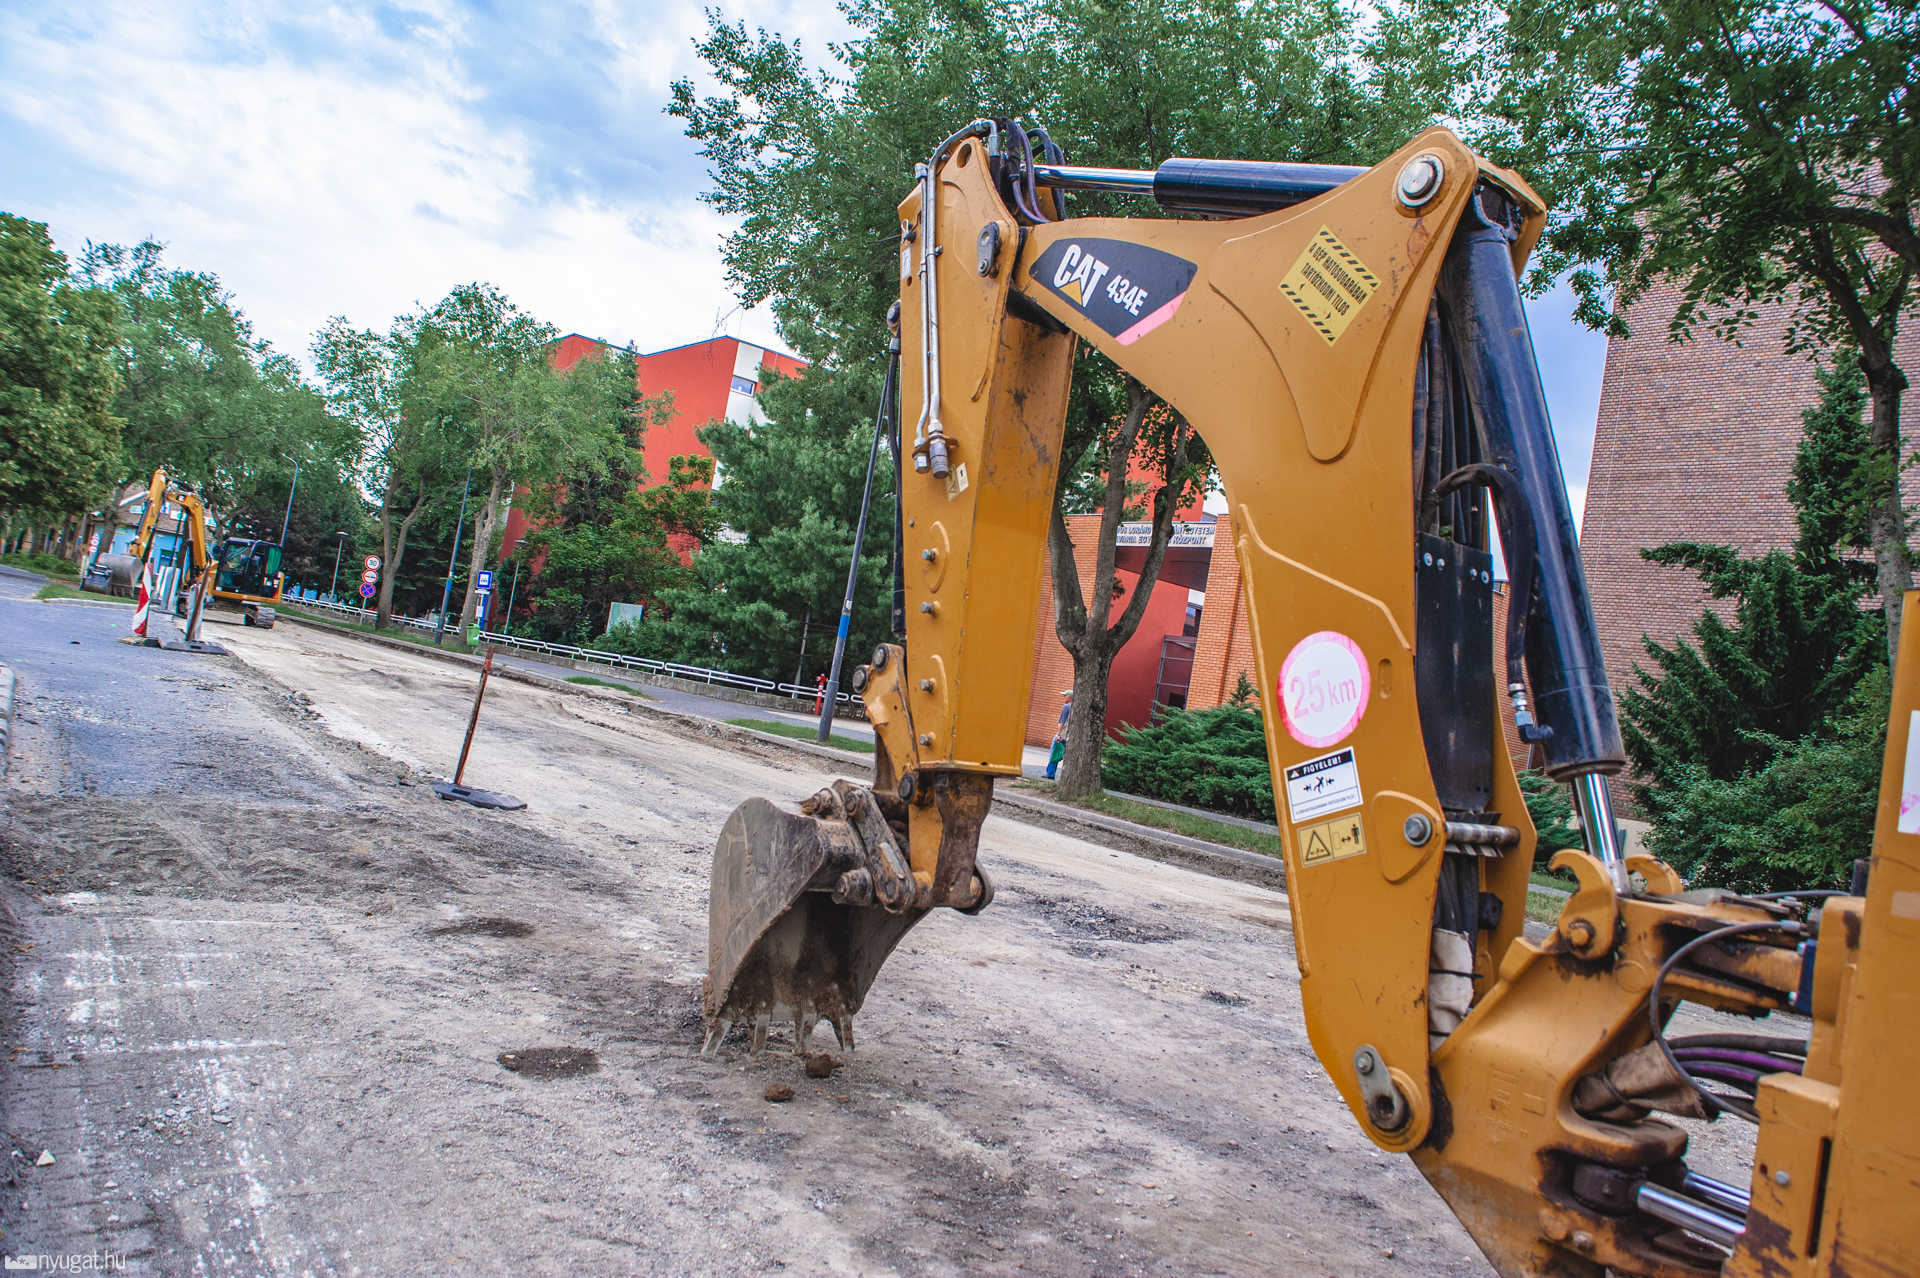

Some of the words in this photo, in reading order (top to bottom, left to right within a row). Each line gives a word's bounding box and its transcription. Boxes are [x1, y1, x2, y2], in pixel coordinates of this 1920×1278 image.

[1053, 244, 1109, 308] CAT
[1106, 275, 1149, 317] 434E
[1290, 670, 1325, 719] 25
[1326, 679, 1357, 707] km
